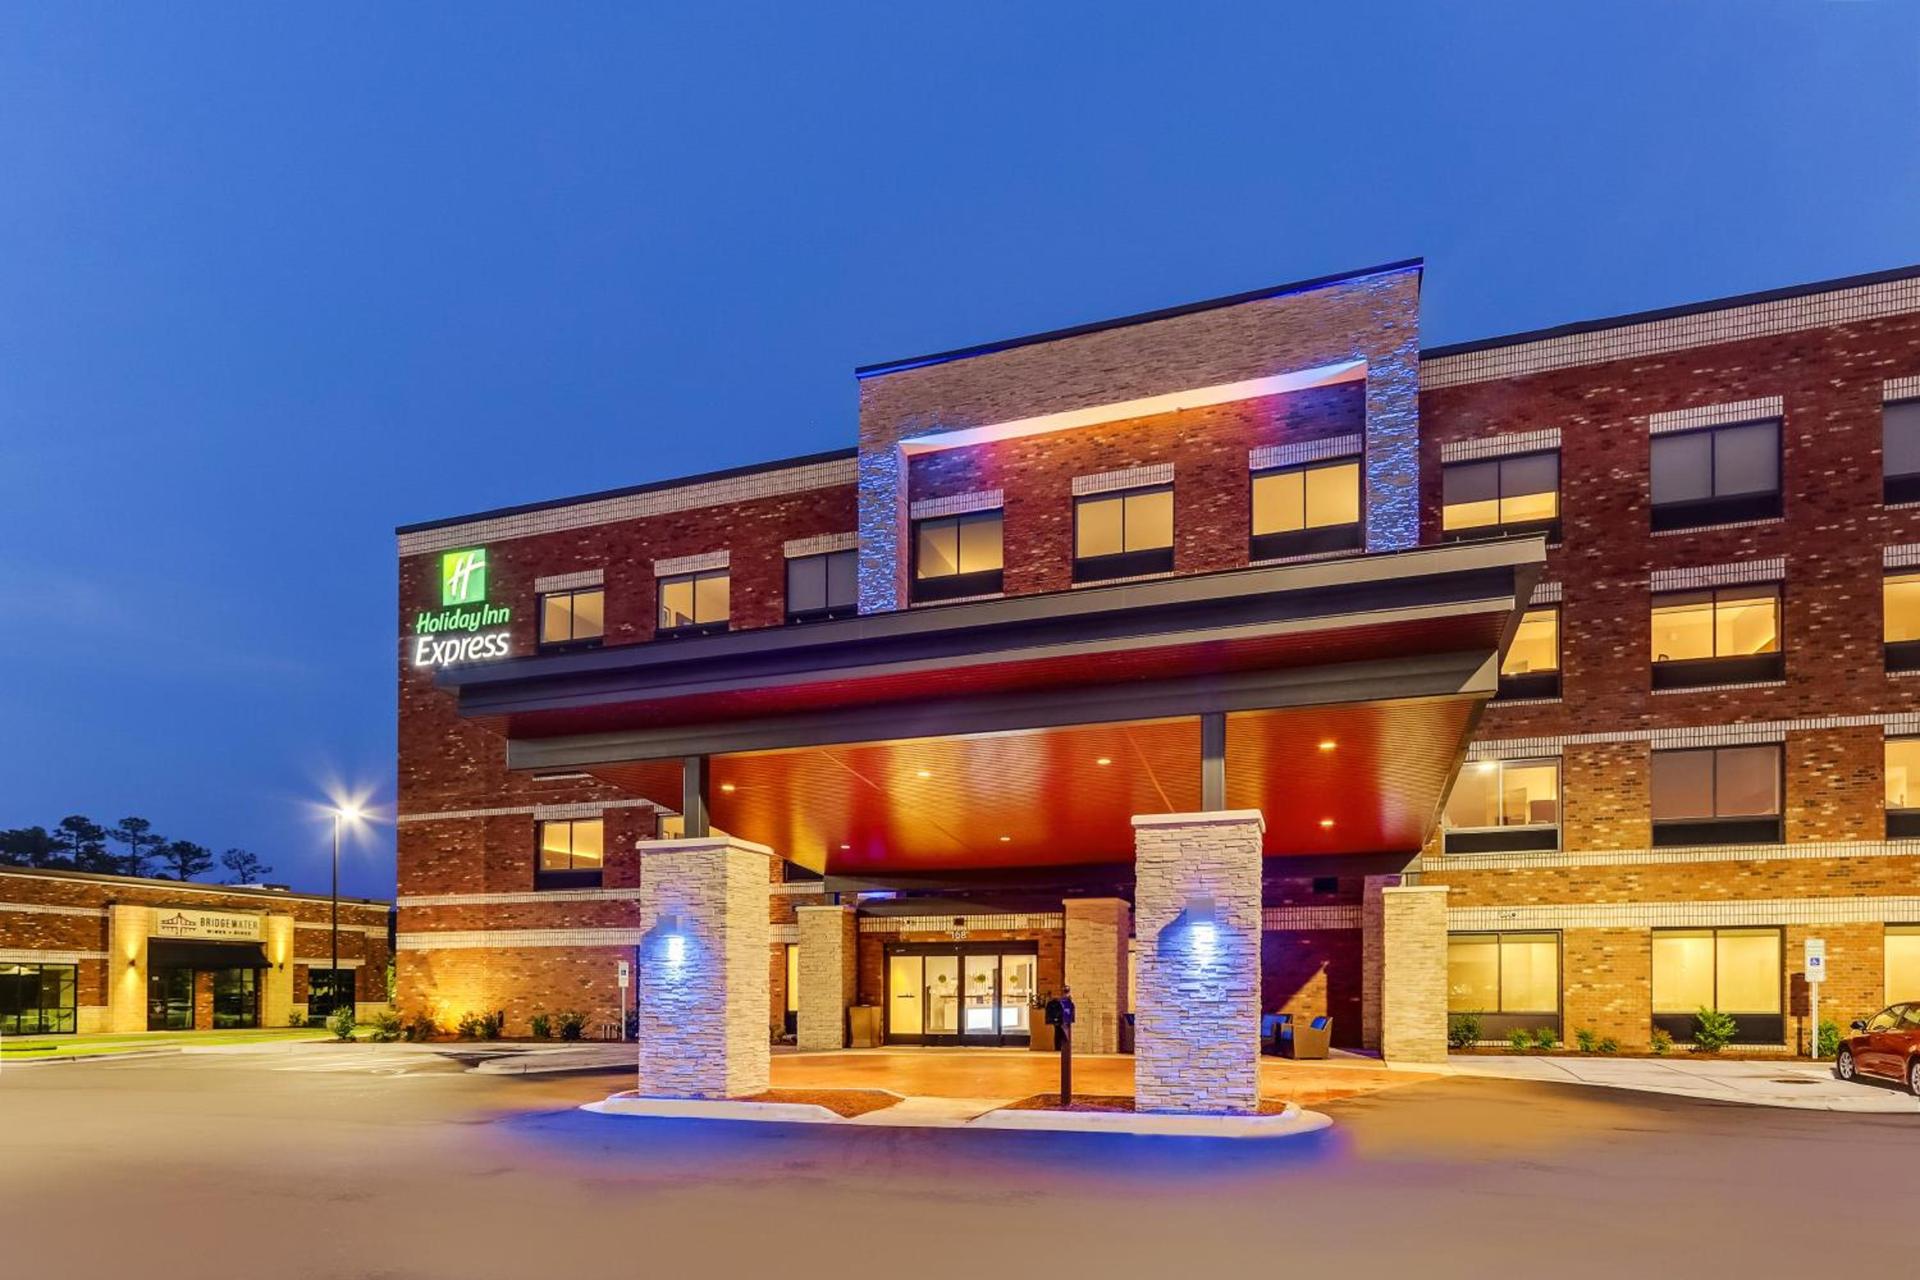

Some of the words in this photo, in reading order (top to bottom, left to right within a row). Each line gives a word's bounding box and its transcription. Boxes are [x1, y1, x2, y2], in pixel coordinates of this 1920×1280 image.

[416, 608, 481, 634] Holiday
[481, 603, 510, 625] Inn
[415, 632, 511, 667] Express
[200, 917, 258, 930] BRIDGEWATER
